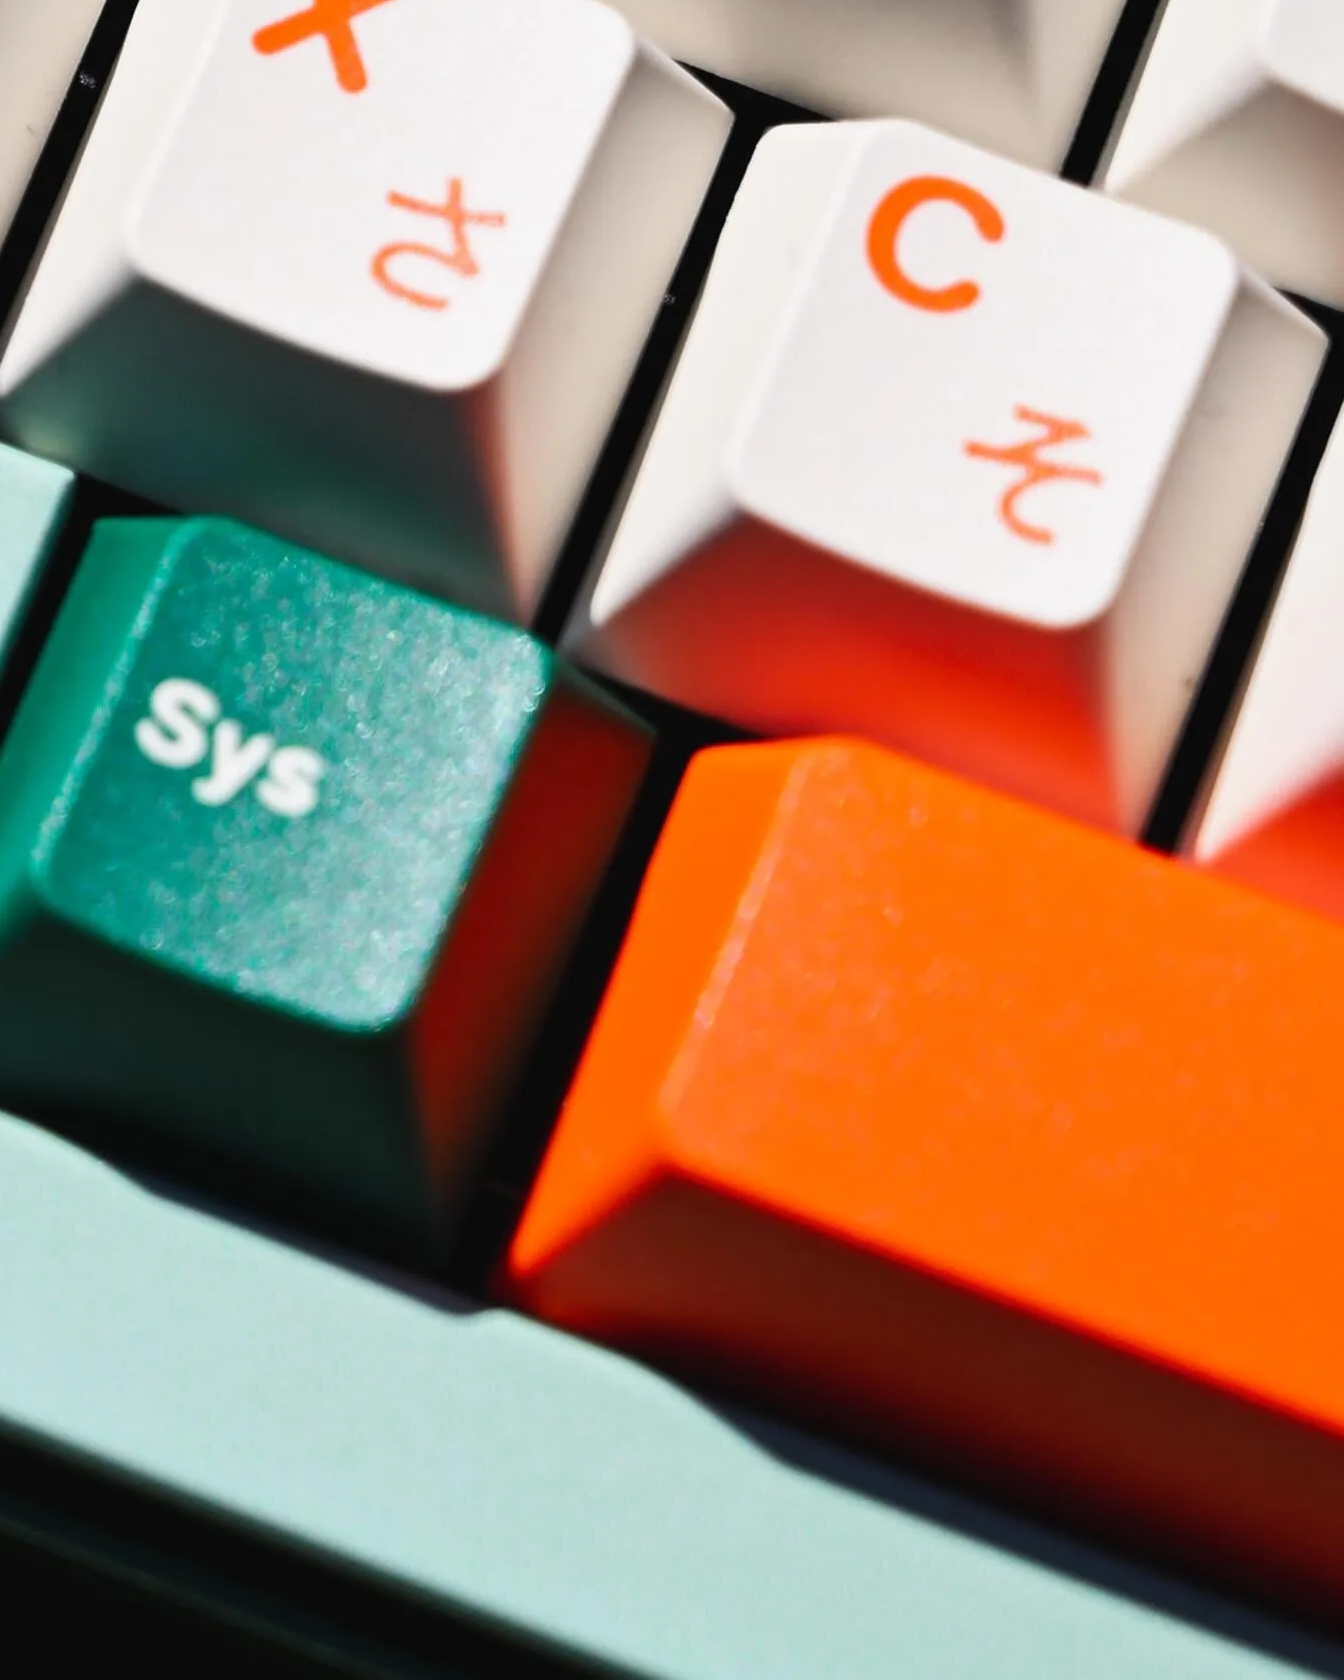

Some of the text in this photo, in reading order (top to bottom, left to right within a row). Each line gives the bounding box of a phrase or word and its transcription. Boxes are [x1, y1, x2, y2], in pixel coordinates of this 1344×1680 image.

[369, 177, 506, 311] さ
[863, 172, 1007, 316] C
[963, 404, 1101, 546] そ
[134, 677, 324, 817] Sys
